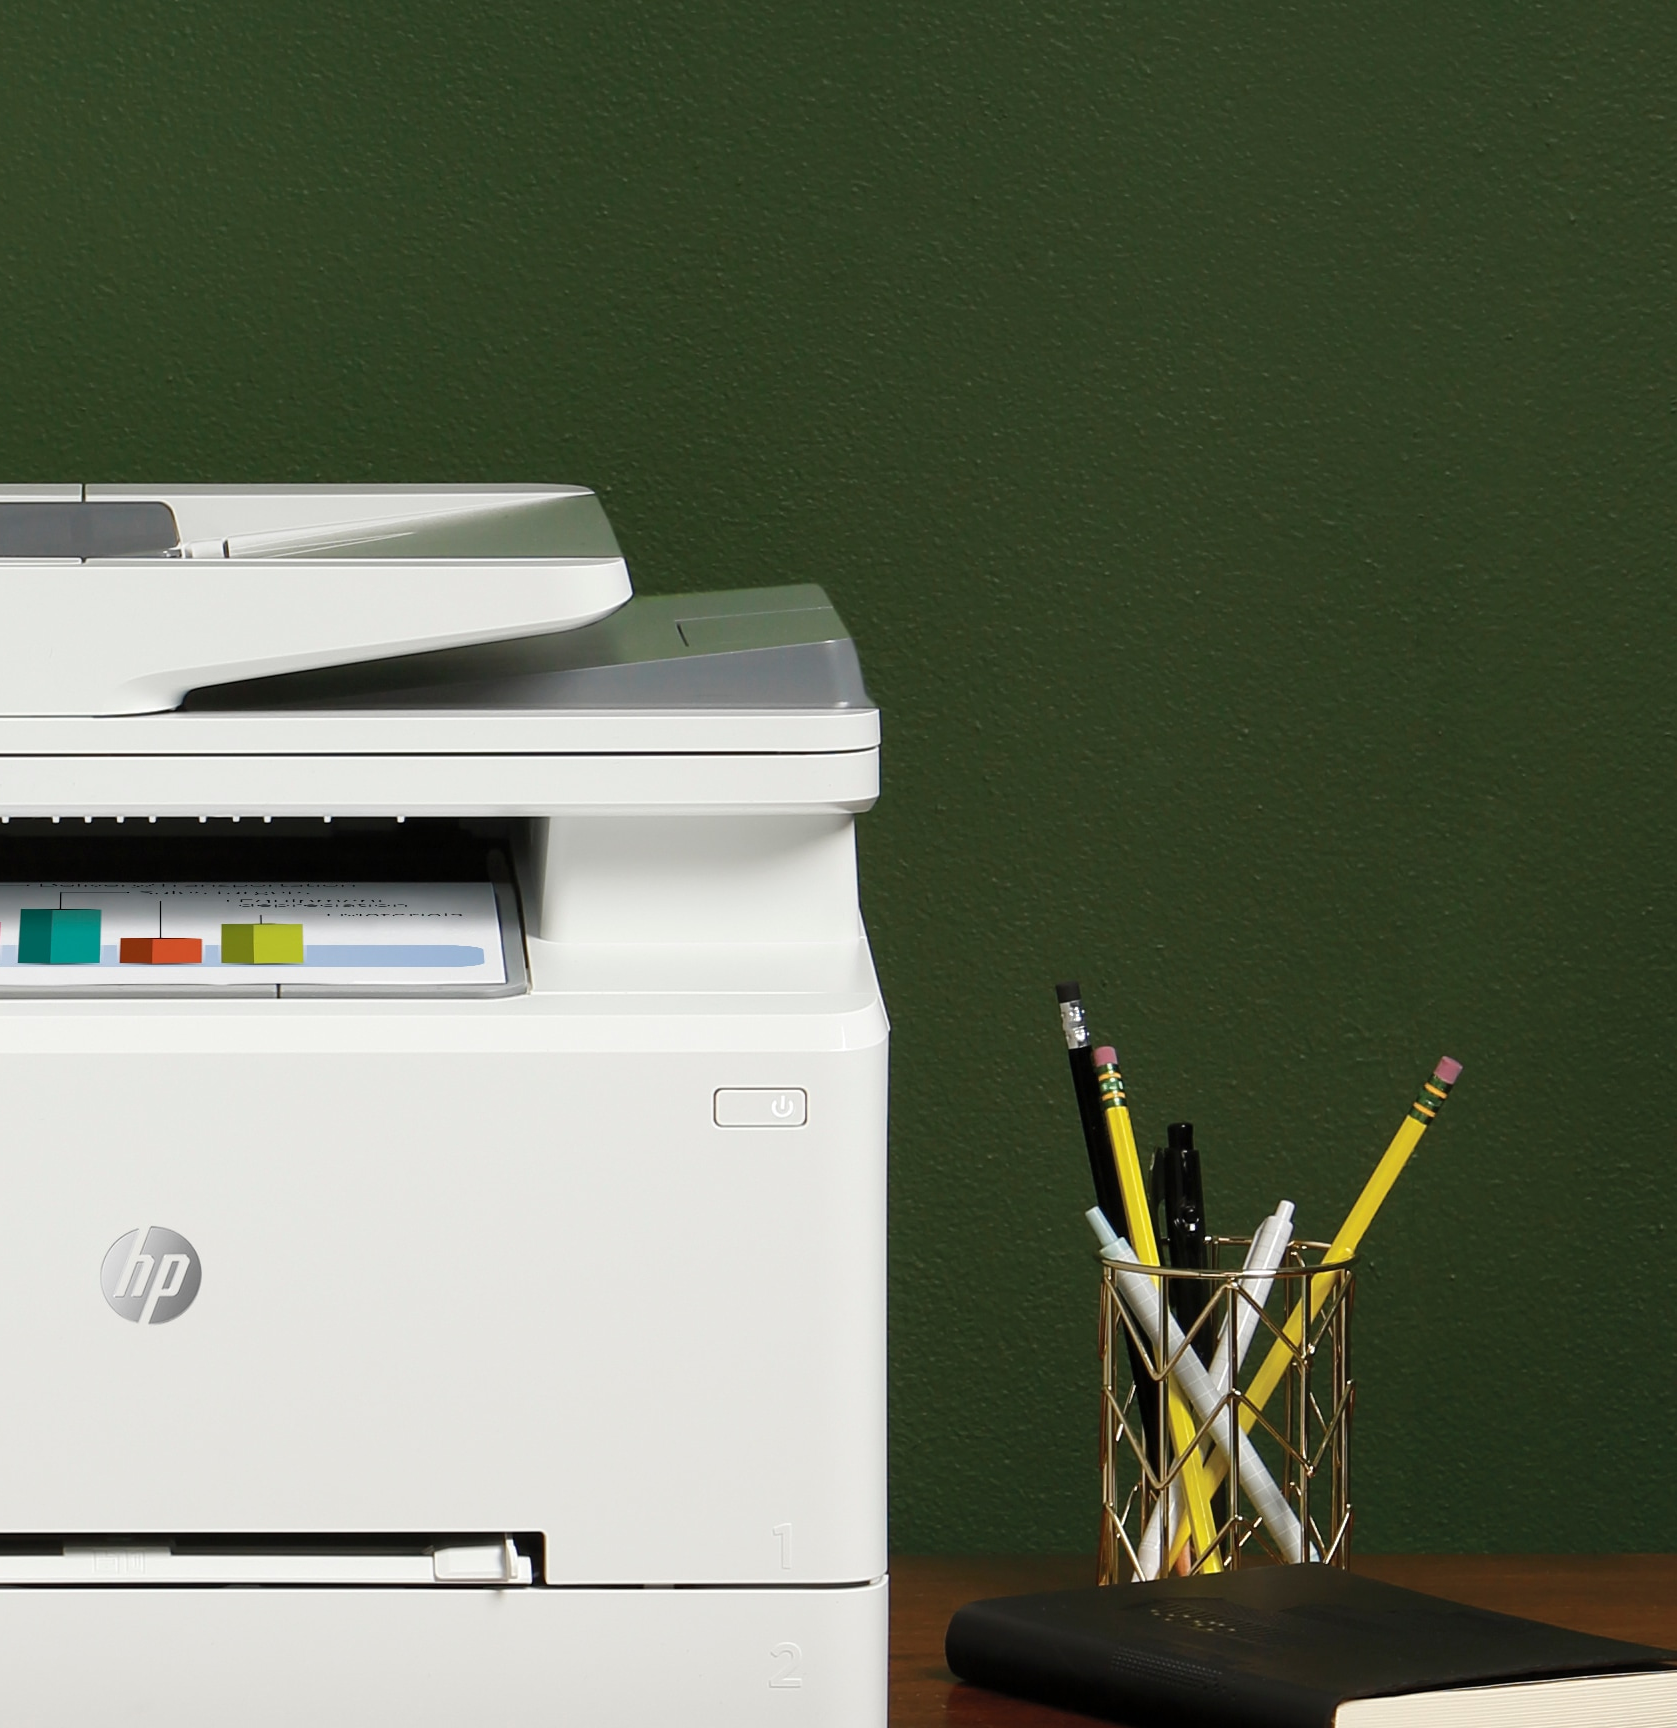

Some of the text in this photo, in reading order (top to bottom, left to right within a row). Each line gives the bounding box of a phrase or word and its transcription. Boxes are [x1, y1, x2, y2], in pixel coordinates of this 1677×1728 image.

[113, 1226, 191, 1324] hp
[773, 1523, 792, 1570] 1
[769, 1642, 802, 1688] 2
